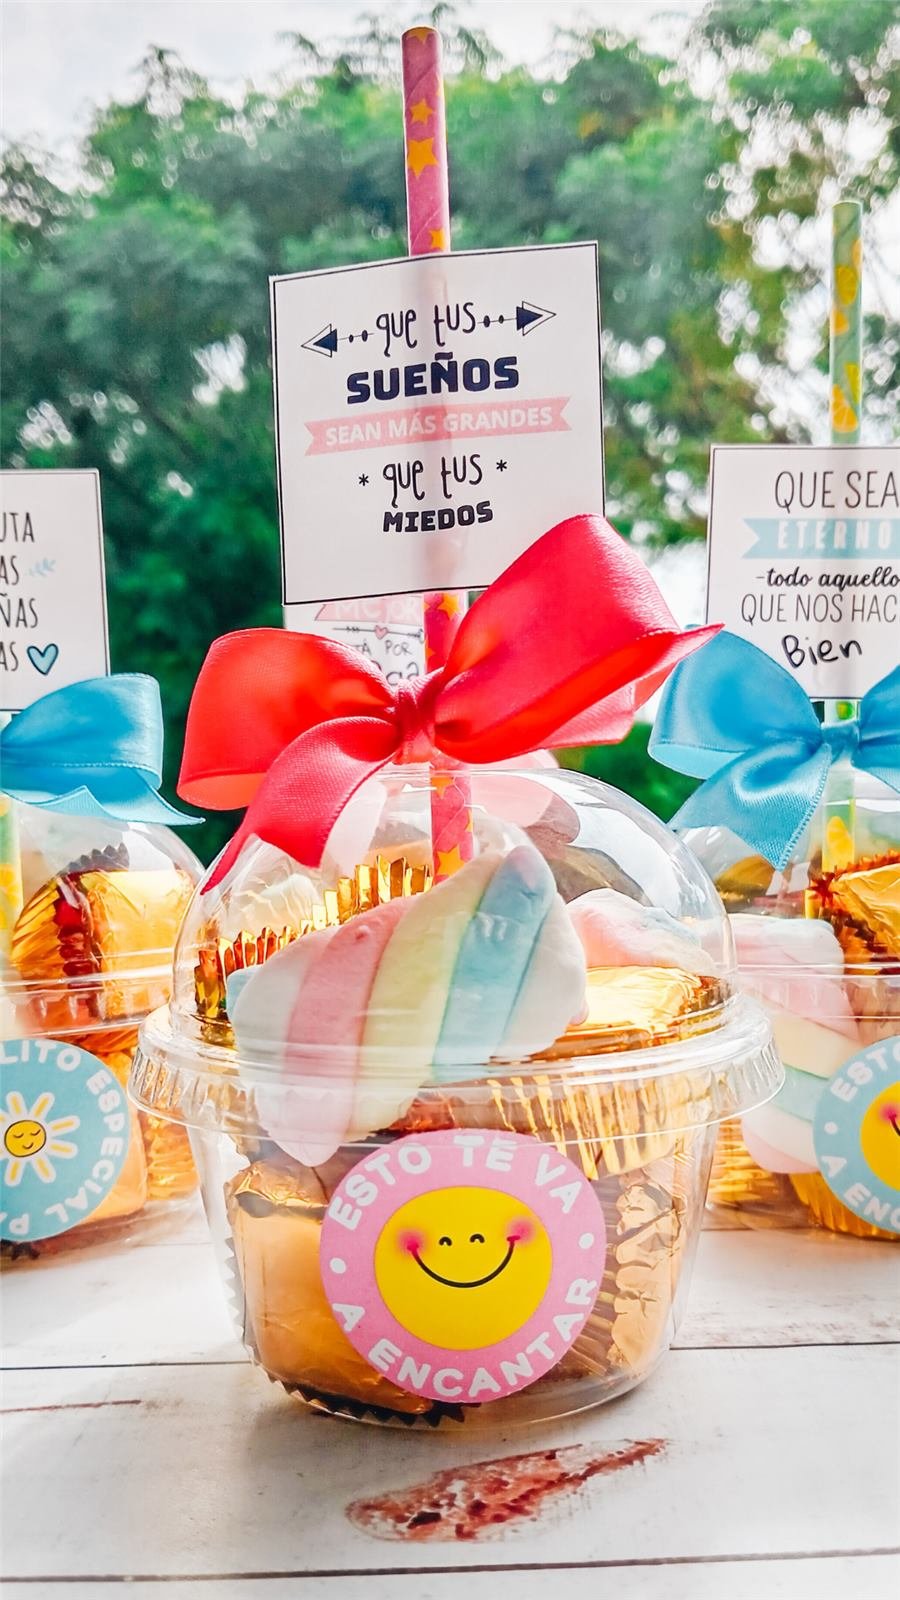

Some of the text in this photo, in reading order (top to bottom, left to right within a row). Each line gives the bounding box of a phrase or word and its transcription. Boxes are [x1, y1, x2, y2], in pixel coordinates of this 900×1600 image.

[376, 301, 477, 357] que tus
[347, 351, 520, 405] SUEÑOS
[325, 406, 554, 446] SEAN MÁS GRANDES
[382, 454, 482, 508] que tus
[774, 470, 900, 514] QUE SEA
[382, 501, 494, 533] MIEDOS
[777, 519, 892, 550] ETERNO
[818, 566, 900, 593] aquello
[741, 593, 900, 626] QUE NOS HAC
[781, 634, 863, 669] Bien
[44, 1069, 126, 1223] ESPECIAL
[820, 1154, 848, 1179] A
[328, 1134, 583, 1231] ESTO TE VA
[332, 1278, 597, 1397] A ENCANTAR
